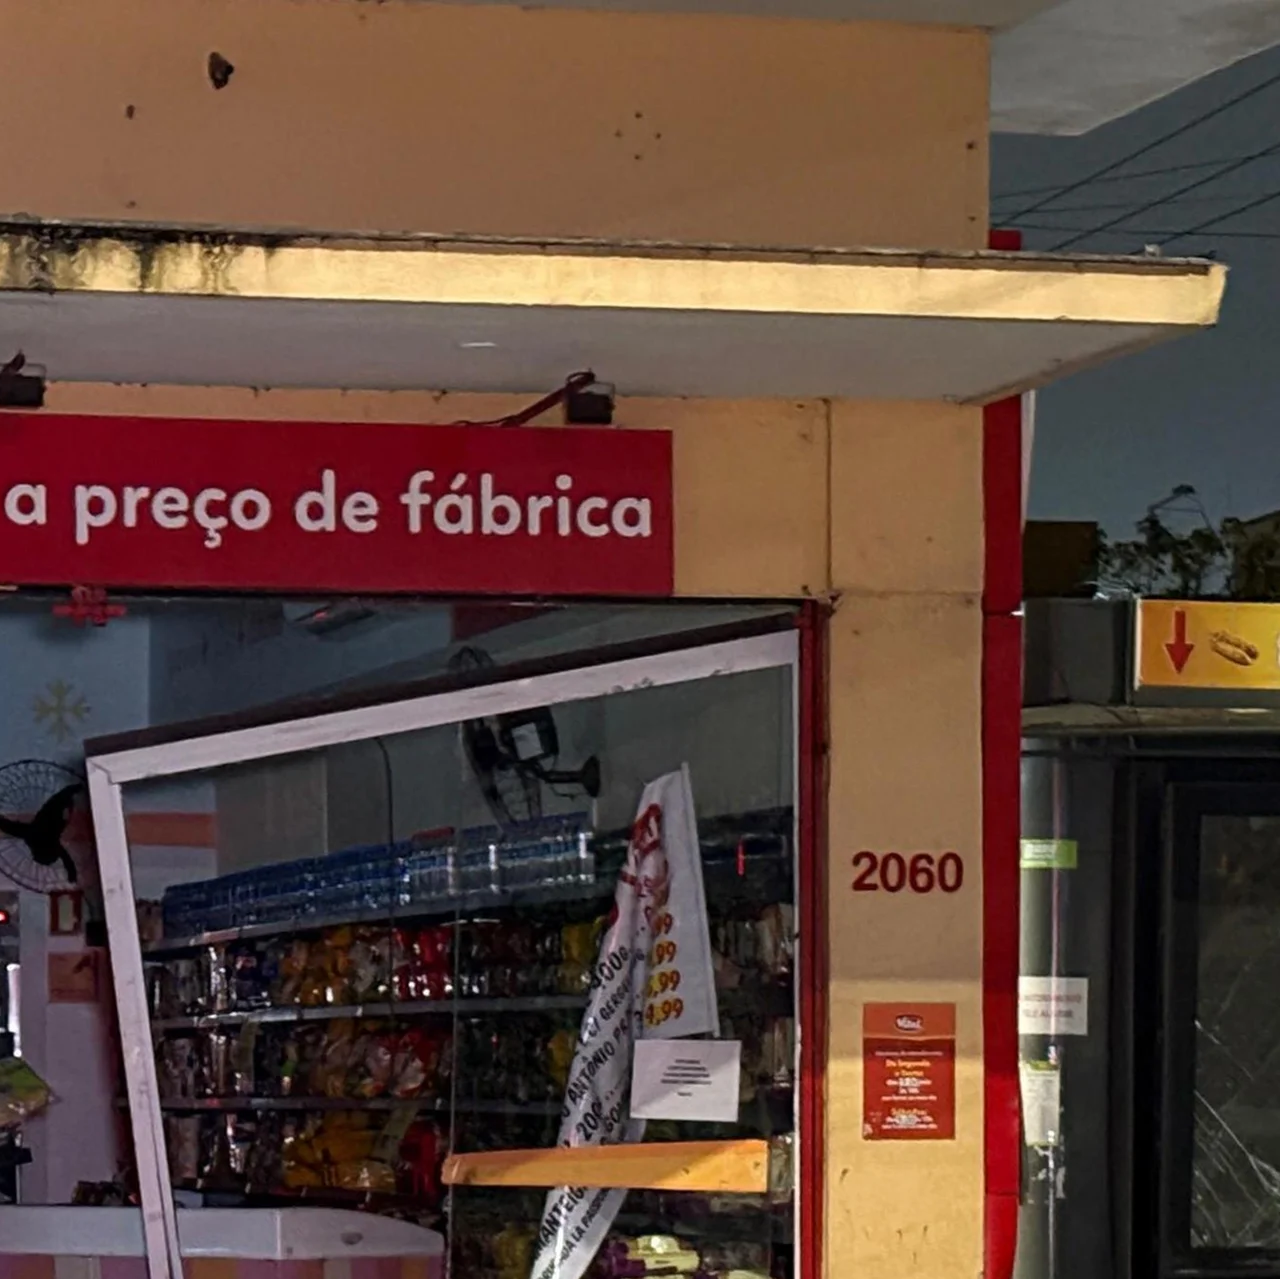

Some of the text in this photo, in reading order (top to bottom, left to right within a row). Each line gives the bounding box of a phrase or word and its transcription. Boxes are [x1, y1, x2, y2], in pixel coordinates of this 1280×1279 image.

[3, 468, 652, 548] a preço de fábrica
[851, 850, 964, 894] 2060
